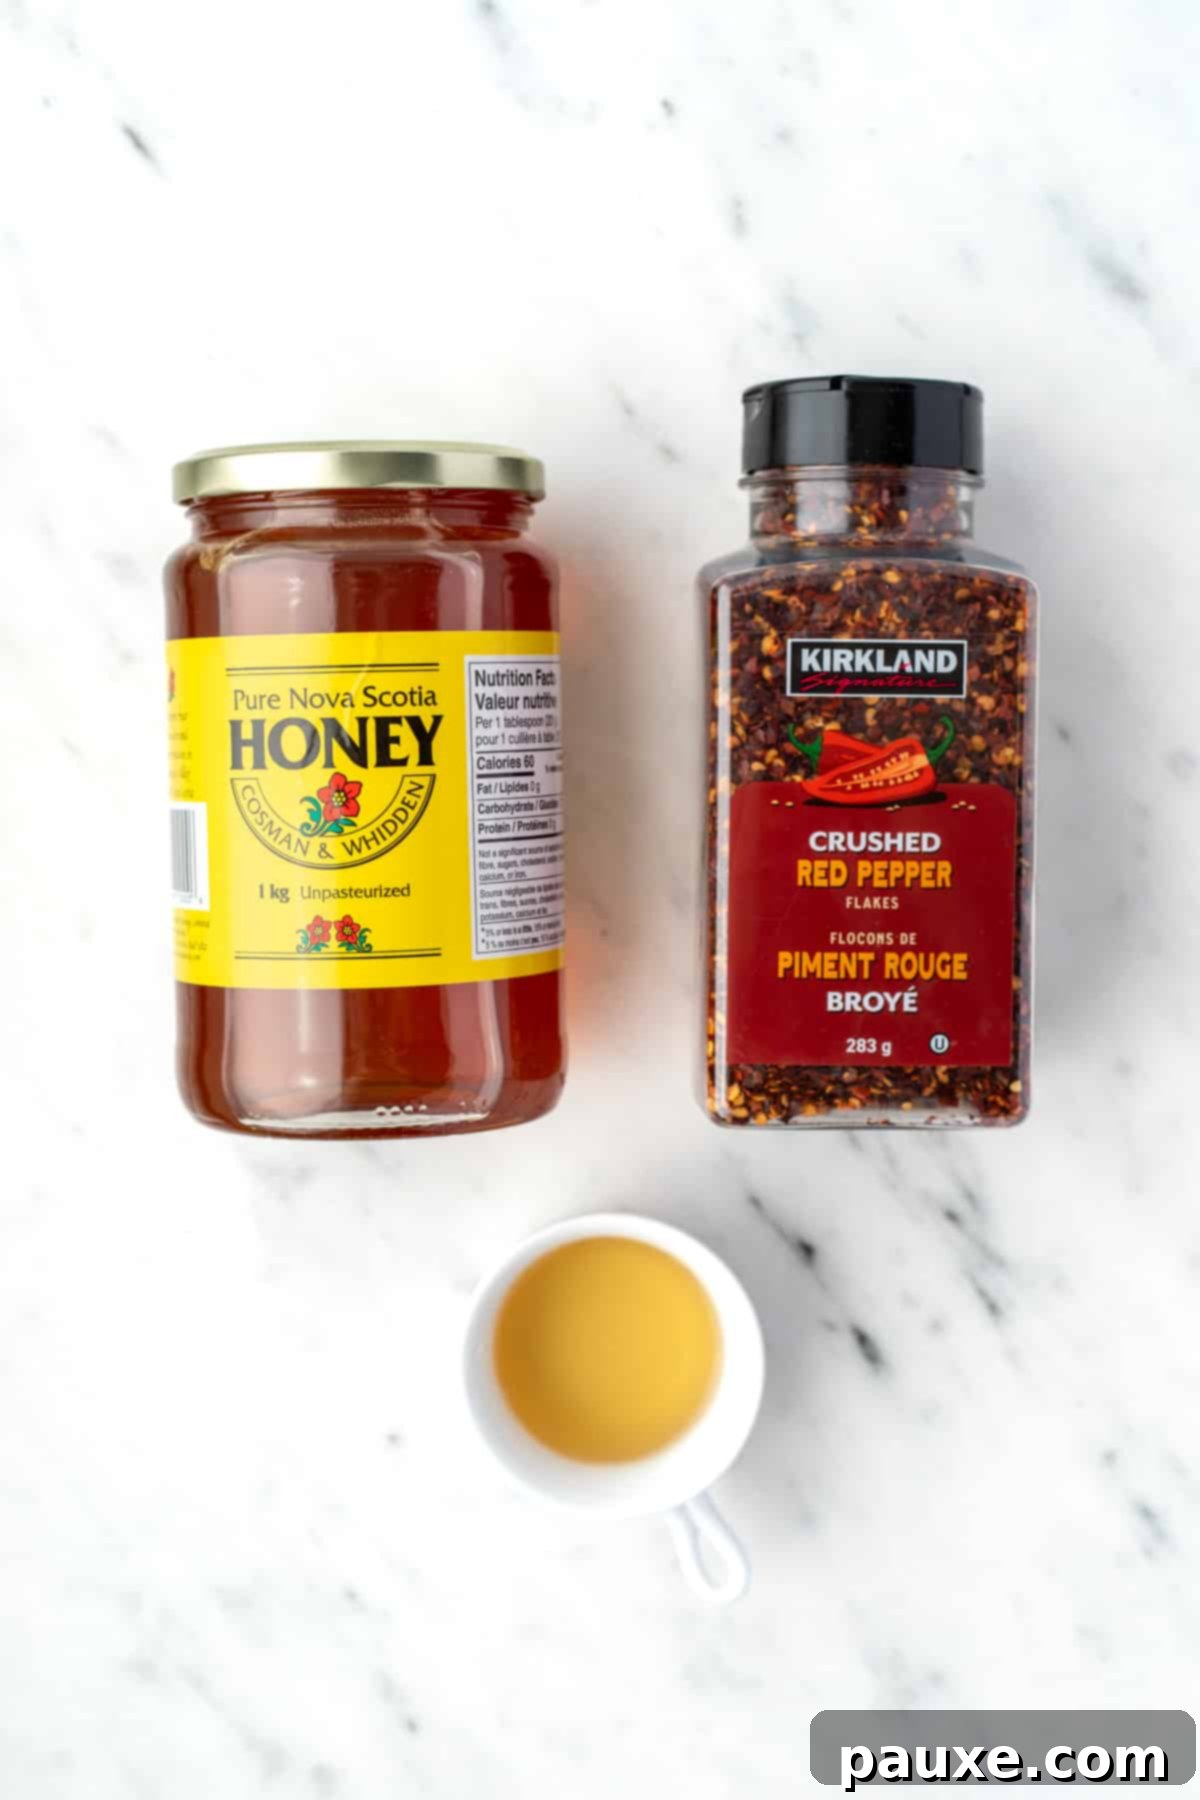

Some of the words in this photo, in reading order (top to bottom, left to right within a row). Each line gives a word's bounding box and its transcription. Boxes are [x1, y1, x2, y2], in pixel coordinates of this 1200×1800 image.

[801, 648, 958, 673] KIRKLAND
[474, 669, 533, 687] Nutrition
[800, 673, 957, 694] Signature
[233, 689, 281, 711] Pure
[289, 687, 355, 709] Nova
[363, 685, 438, 708] Scotia
[474, 692, 520, 710] Valeur
[475, 716, 493, 729] Per
[229, 714, 444, 770] HONEY
[475, 734, 499, 748] pour
[476, 755, 522, 770] Calories
[523, 754, 535, 769] 60
[476, 783, 492, 795] Fat
[499, 780, 529, 796] Lipides
[477, 800, 534, 815] Carbohydrate
[241, 784, 310, 857] COSMAN
[317, 842, 335, 860] &
[341, 780, 425, 857] WHIDDEN
[478, 821, 511, 835] Protein
[808, 831, 941, 854] CRUSHED
[797, 860, 848, 888] RED
[857, 860, 952, 890] PEPPER
[259, 884, 265, 899] 1
[270, 884, 290, 903] kg
[299, 884, 411, 904] Unpasteurized
[845, 896, 900, 910] FLAKES
[829, 931, 894, 946] FLOCONS
[900, 932, 917, 946] DE
[777, 951, 875, 980] PIMENT
[885, 951, 968, 981] ROUGE
[826, 987, 919, 1014] BROYÉ
[845, 1038, 877, 1053] 283
[881, 1041, 892, 1056] g
